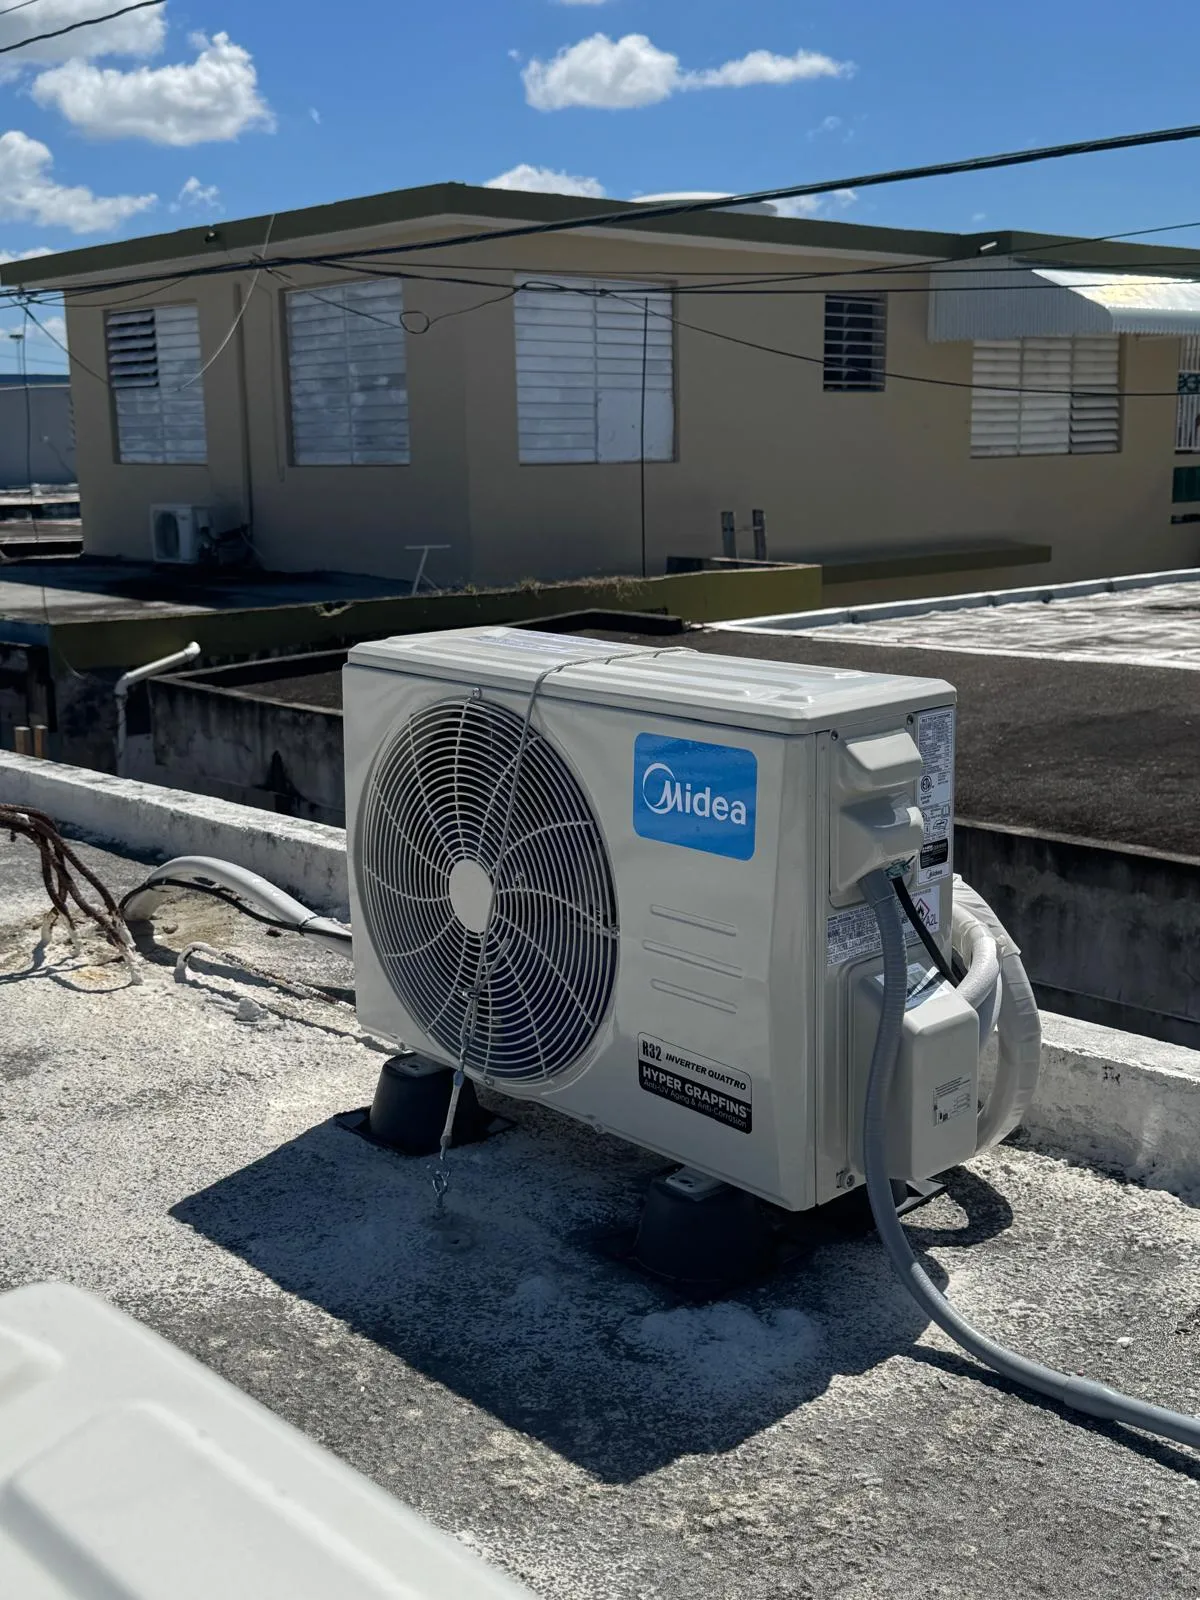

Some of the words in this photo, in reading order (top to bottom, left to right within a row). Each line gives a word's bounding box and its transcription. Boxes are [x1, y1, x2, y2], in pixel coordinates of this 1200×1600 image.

[642, 762, 747, 826] Midea
[642, 1040, 662, 1062] R32
[665, 1053, 708, 1075] INVERTER
[708, 1069, 746, 1091] QUATTRO
[643, 1066, 682, 1092] HYPER
